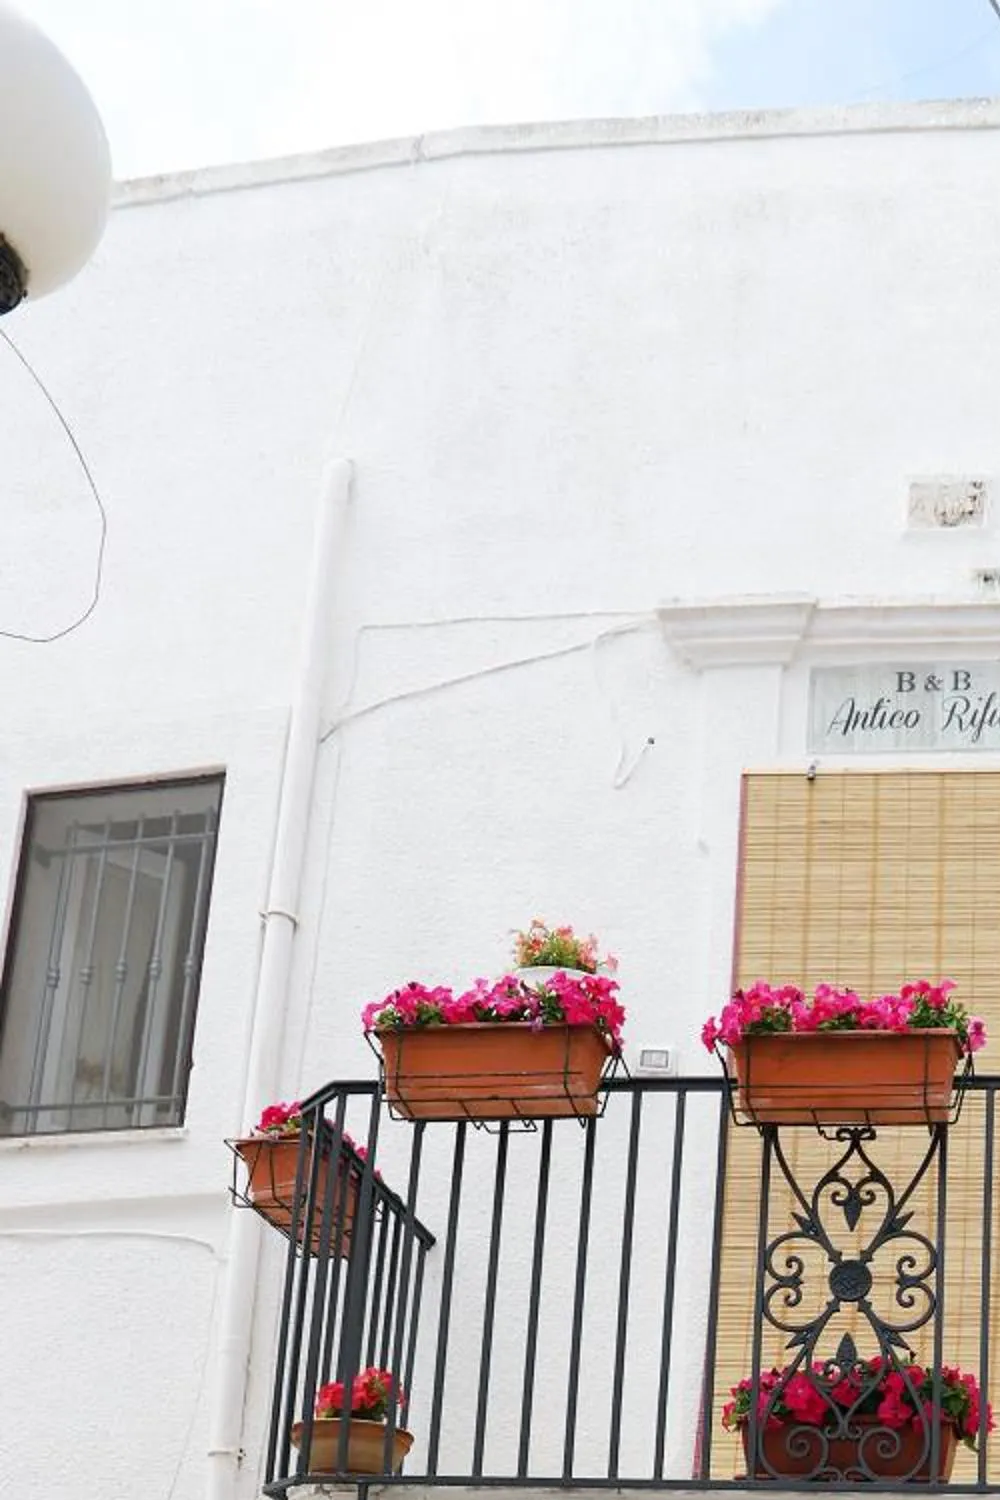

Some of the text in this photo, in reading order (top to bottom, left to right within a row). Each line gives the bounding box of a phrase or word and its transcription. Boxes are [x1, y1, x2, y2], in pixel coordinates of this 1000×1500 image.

[896, 670, 972, 692] B & B
[827, 697, 921, 736] Antico
